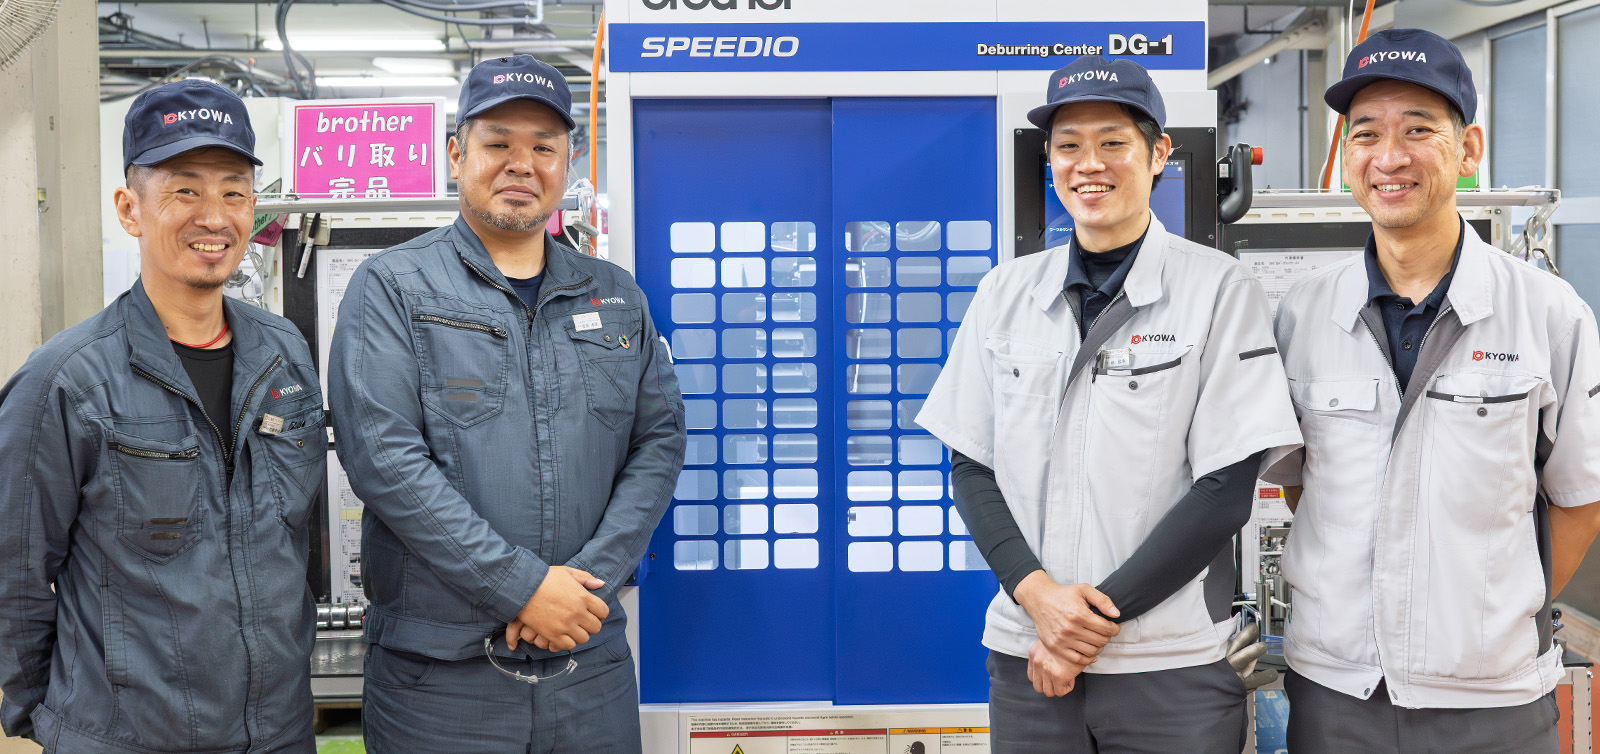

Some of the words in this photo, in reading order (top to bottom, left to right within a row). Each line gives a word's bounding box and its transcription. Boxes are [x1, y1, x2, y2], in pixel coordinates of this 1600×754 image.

[641, 36, 799, 57] SPEEDIO
[977, 43, 1049, 57] Deburring
[1053, 43, 1102, 55] Center
[1108, 33, 1173, 55] DG-1
[1369, 51, 1427, 63] KYOWA
[506, 73, 554, 90] KYOWA
[1068, 70, 1118, 84] KYOWA
[178, 108, 233, 124] KYOWA
[317, 110, 413, 133] brother
[299, 143, 427, 168] バリ取り
[1142, 334, 1176, 342] KYOWA
[1485, 352, 1519, 361] KYOWA
[280, 384, 302, 396] KYOWA
